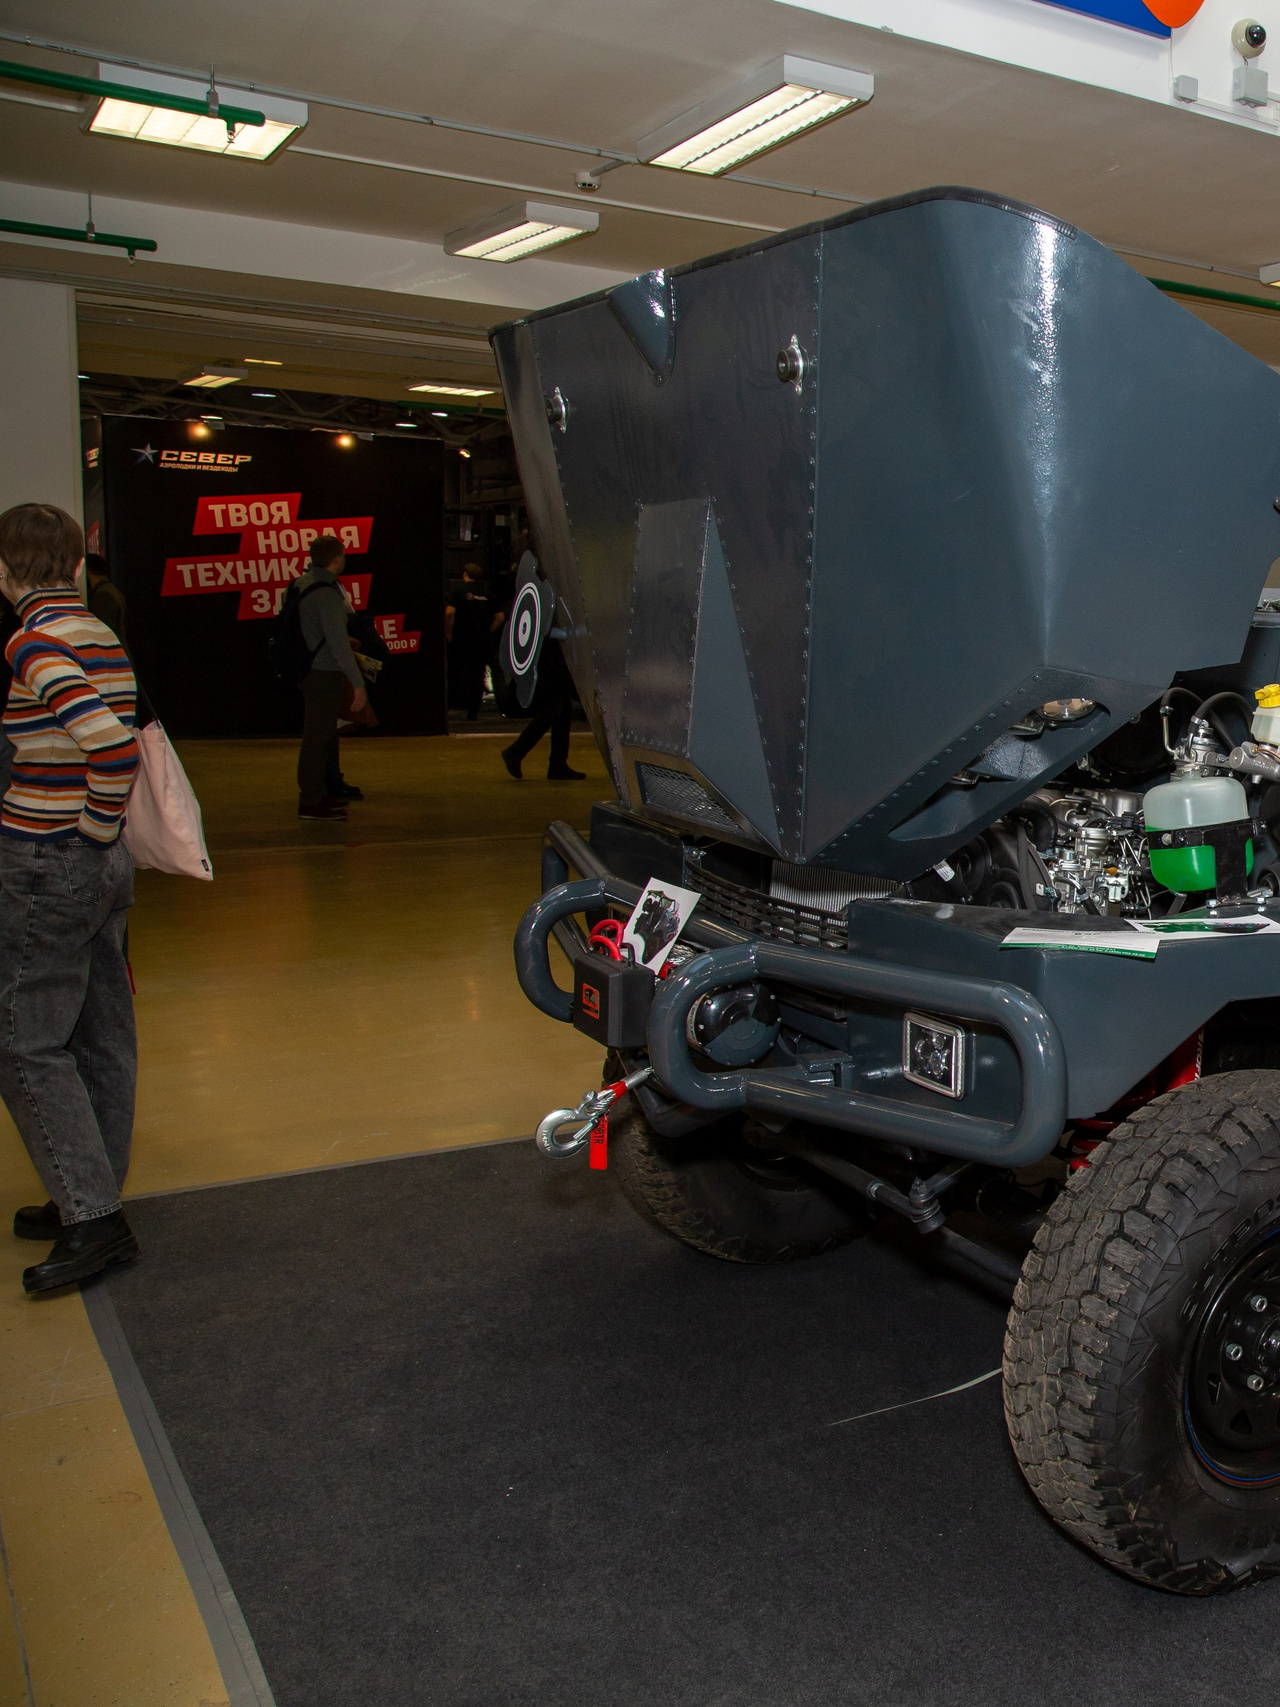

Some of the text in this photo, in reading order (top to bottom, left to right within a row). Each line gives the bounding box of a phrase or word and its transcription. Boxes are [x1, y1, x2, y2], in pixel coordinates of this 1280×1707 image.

[161, 450, 252, 465] СЕВЕР
[159, 462, 196, 470] АЭРОЛОДКИ
[202, 464, 239, 473] ВЕЗДЕХОДЫ
[208, 501, 290, 528] ТВОЯ
